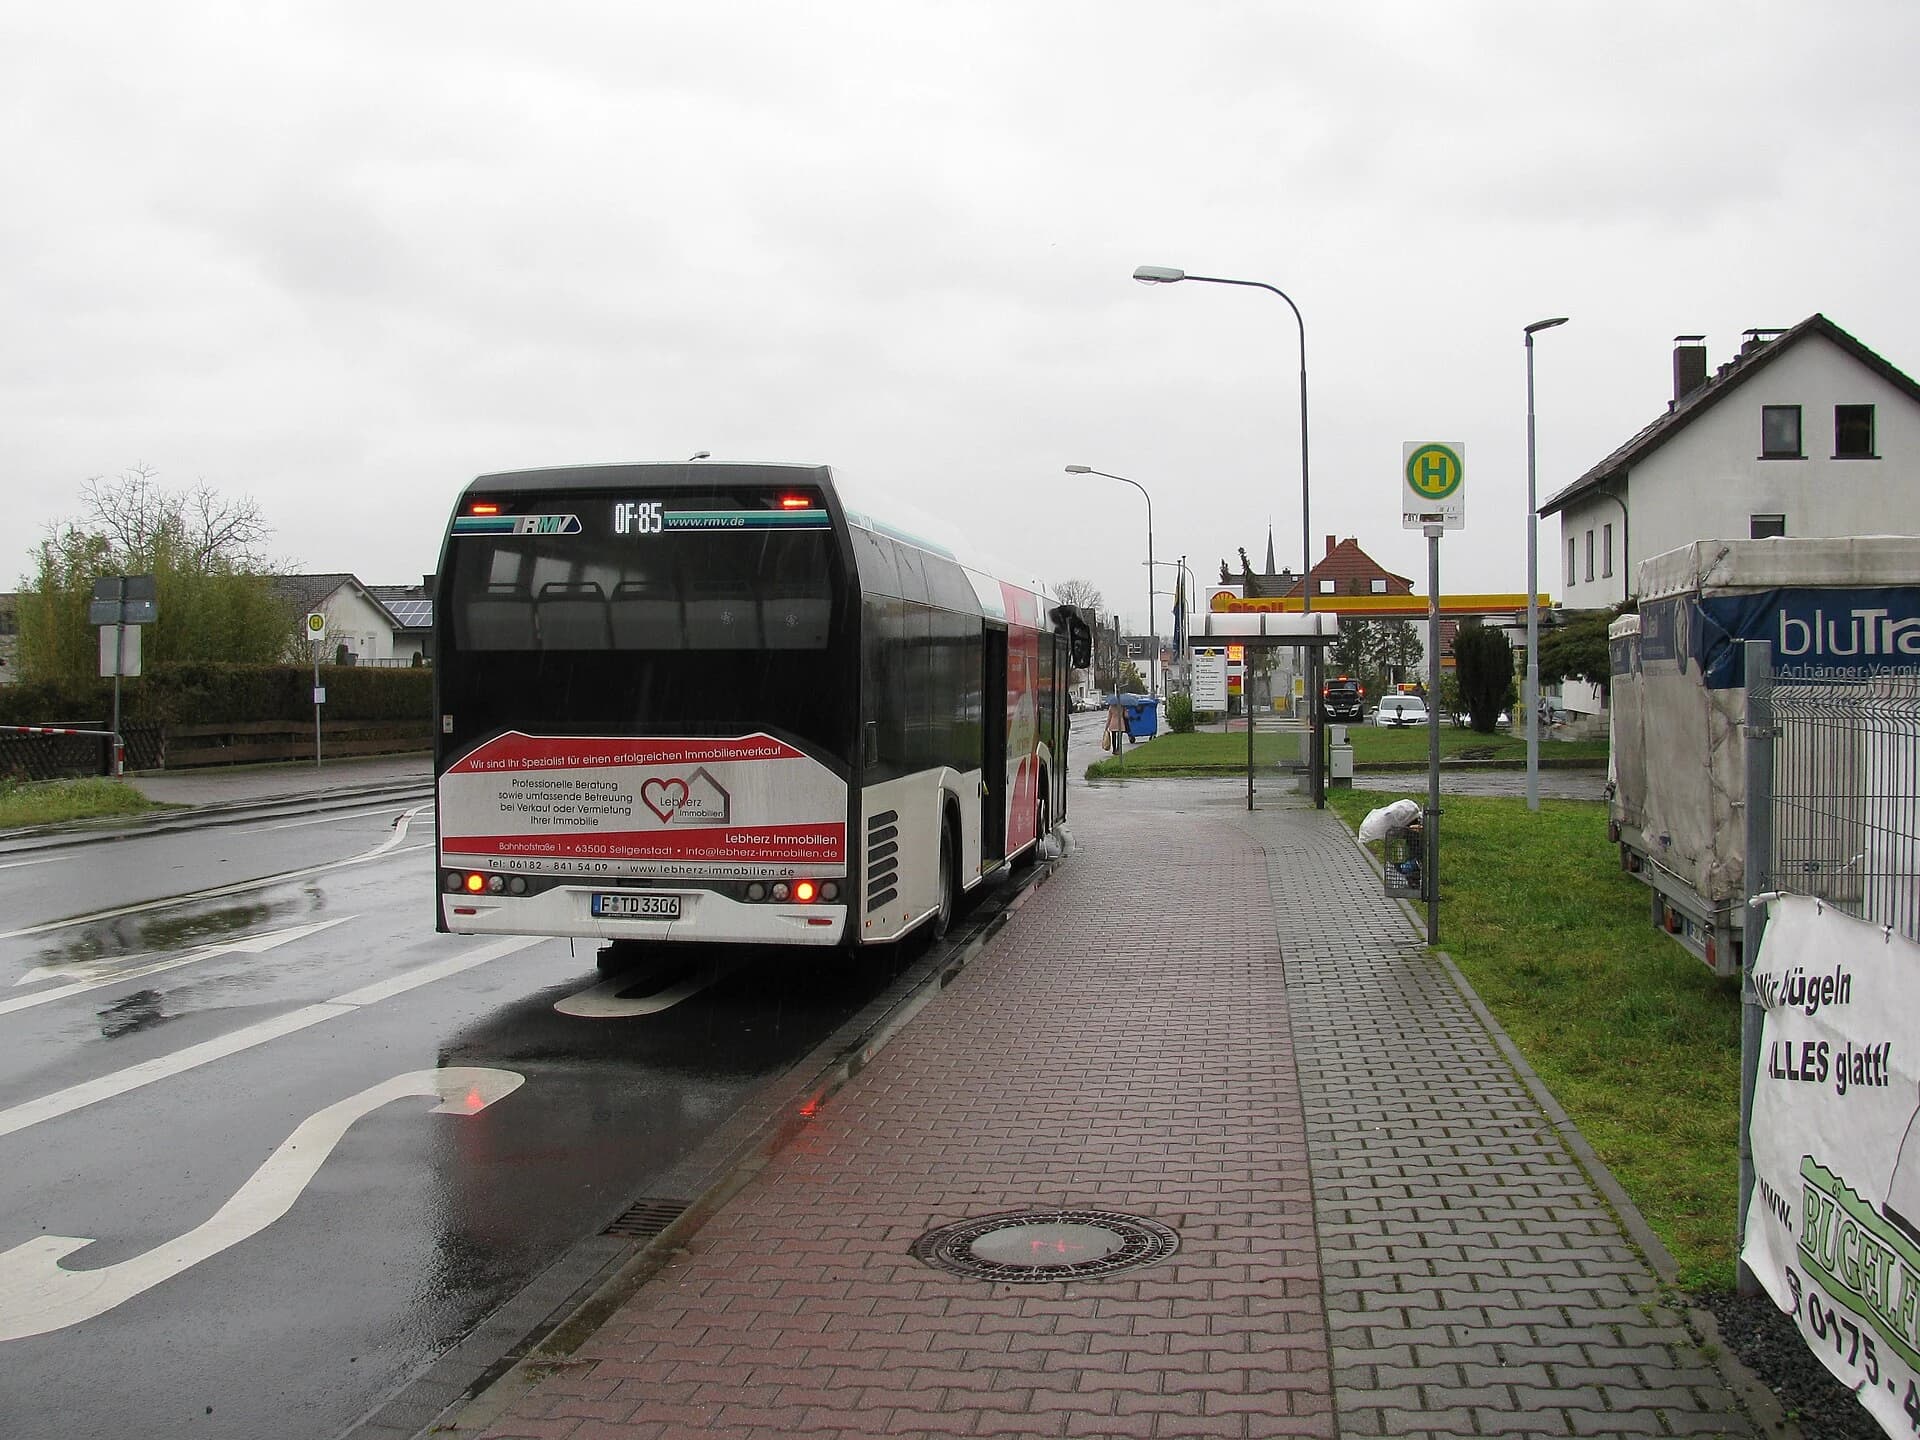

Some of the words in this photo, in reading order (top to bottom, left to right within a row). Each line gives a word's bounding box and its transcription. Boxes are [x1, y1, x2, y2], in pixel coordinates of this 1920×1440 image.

[1421, 457, 1447, 487] H
[523, 516, 573, 534] RMV
[615, 503, 662, 534] OF-85
[668, 517, 745, 528] www.rmv.de
[1227, 601, 1284, 613] Shell
[1780, 661, 1920, 681] Anhänger-Vermi
[470, 760, 484, 769] Wir
[486, 758, 505, 769] sind
[508, 758, 519, 768] Ihr
[522, 756, 565, 768] Spezialist
[567, 754, 580, 765] für
[583, 754, 611, 764] einen
[614, 750, 682, 763] erfolgreichen
[685, 746, 781, 760] Immobilienverkauf
[512, 779, 573, 790] Professionelle
[576, 780, 618, 791] Beratung
[498, 791, 523, 800] sowie
[526, 791, 582, 801] umfassende
[585, 793, 633, 804] Betreuung
[660, 797, 702, 807] Lebherz
[501, 803, 515, 812] bei
[518, 804, 551, 813] Verkauf
[553, 804, 576, 814] oder
[578, 805, 632, 816] Vermietung
[530, 816, 551, 825] Ihrer
[553, 816, 599, 826] Immobilie
[725, 833, 770, 844] Lebherz
[774, 834, 837, 845] Immobilien
[499, 842, 555, 851] Bahnhofstraße
[575, 845, 606, 853] 63500
[609, 845, 672, 856] Seligenstadt
[685, 847, 837, 858] info@lebherz-immobilien.de
[488, 859, 506, 869] Tel:
[510, 860, 542, 869] 06182
[553, 862, 573, 871] 841
[578, 862, 590, 871] 54
[594, 862, 608, 872] 09
[630, 864, 795, 876] www.lebherz-immobilien.de
[601, 897, 611, 911] F
[621, 898, 639, 912] TD
[642, 898, 678, 913] 3306
[1755, 972, 1779, 1009] Wir
[1836, 1042, 1891, 1095] glatt!
[1800, 1183, 1920, 1345] BÜGELF
[1808, 1292, 1879, 1386] 0175
